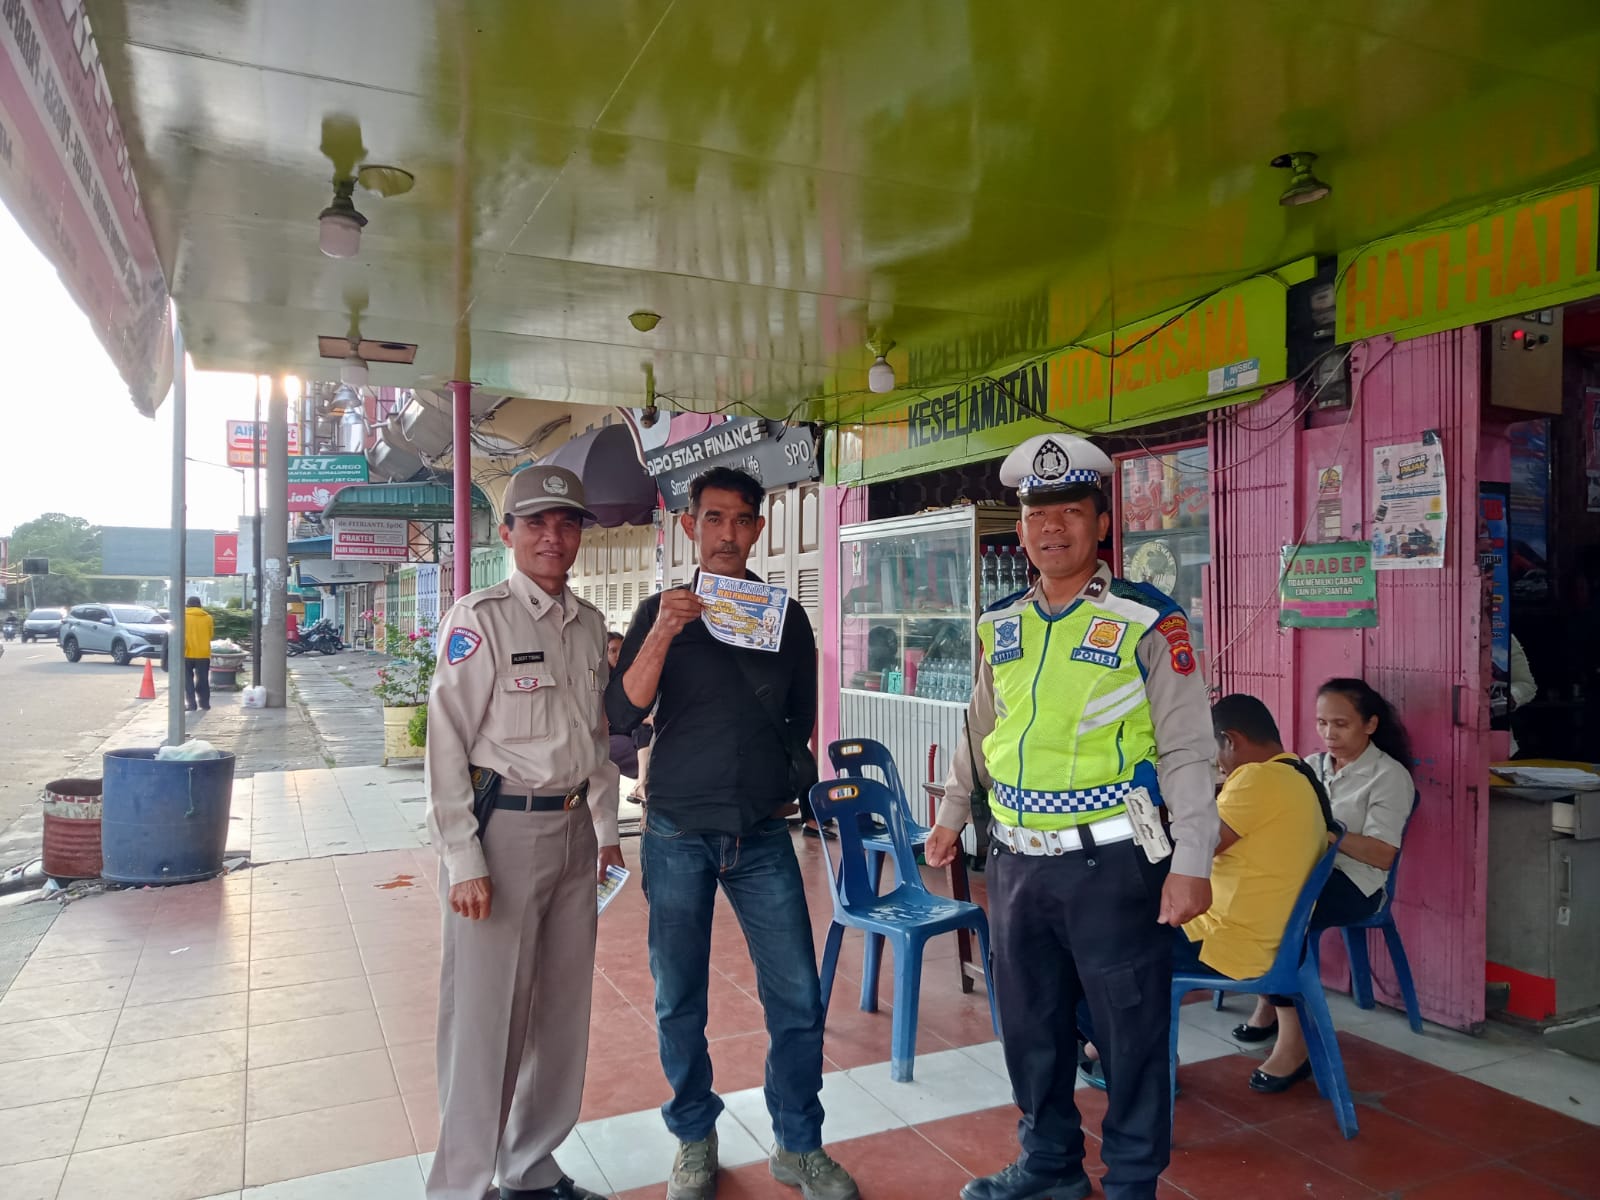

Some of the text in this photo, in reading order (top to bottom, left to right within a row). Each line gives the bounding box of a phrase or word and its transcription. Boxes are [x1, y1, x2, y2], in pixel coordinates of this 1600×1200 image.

[1345, 186, 1592, 335] HATI-HATI
[909, 362, 1048, 449] KESELAMATAN
[1050, 346, 1104, 412] KITA
[1110, 295, 1249, 395] BERSAMA
[646, 456, 672, 477] DIPO
[672, 445, 705, 469] STAR
[704, 420, 761, 459] FINANCE
[784, 439, 810, 466] SPO
[288, 458, 336, 471] J&T
[288, 491, 312, 503] ion
[341, 534, 374, 543] PRAKTEK
[1288, 577, 1363, 587] TIDAK MEMILIKI CABANG
[1325, 587, 1353, 596] SIANTAR
[1073, 650, 1117, 666] POLISI
